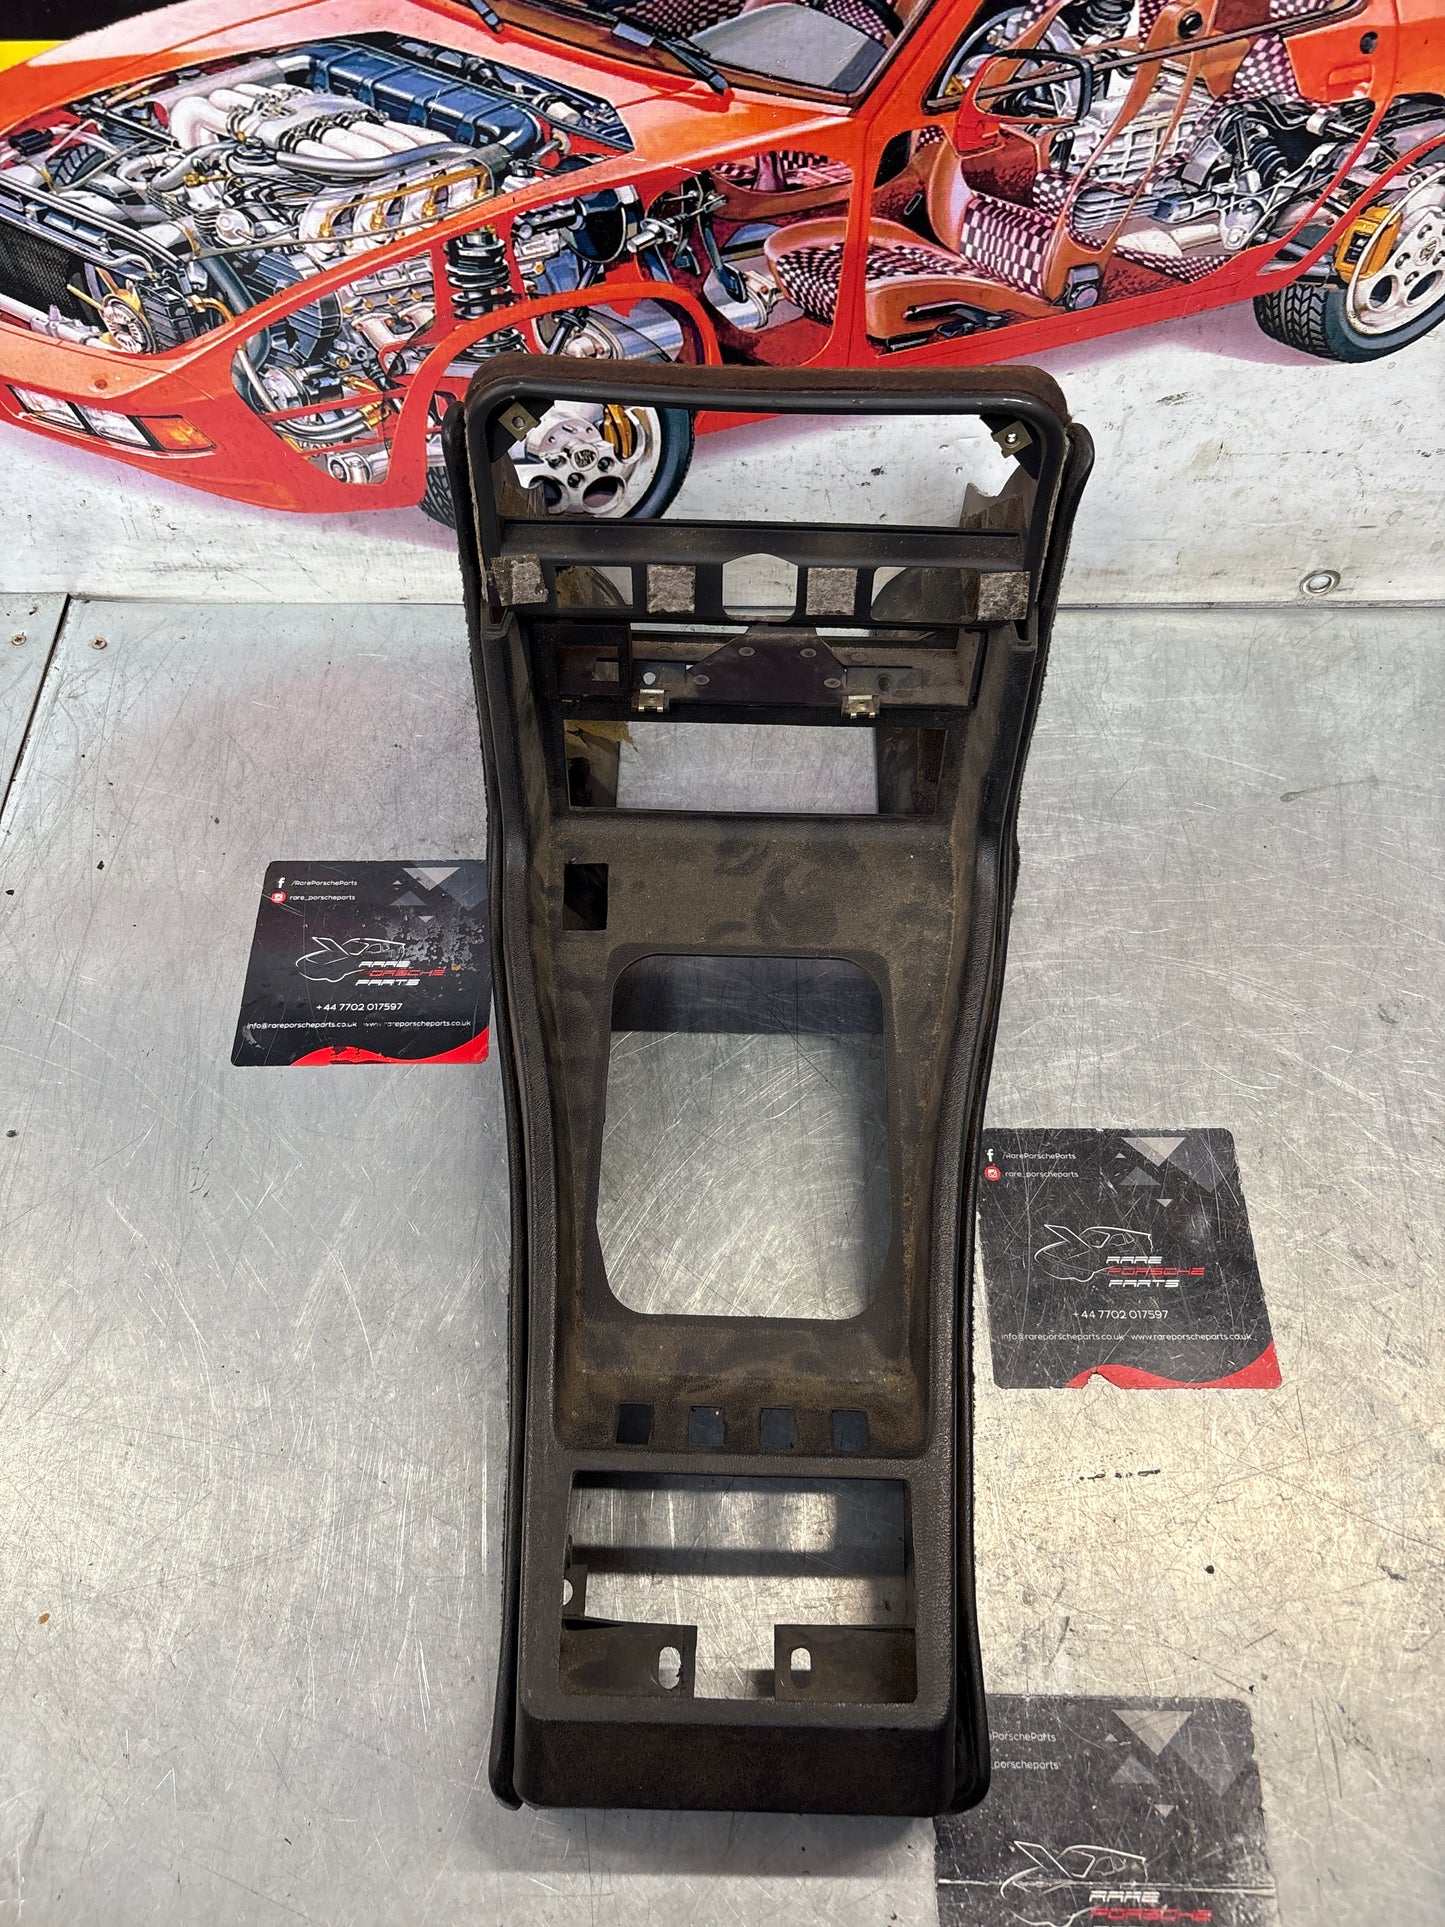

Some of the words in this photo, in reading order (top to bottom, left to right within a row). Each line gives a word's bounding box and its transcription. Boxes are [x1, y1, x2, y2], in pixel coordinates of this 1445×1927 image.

[358, 960, 411, 968] RARE
[361, 969, 446, 977] ORSCHE
[355, 979, 420, 987] PARTS
[316, 1003, 337, 1011] +44
[339, 1003, 365, 1011] 7702
[366, 1002, 403, 1011] 017597
[246, 1021, 358, 1030] info@rareporscheparts.co.uk
[1001, 1152, 1077, 1160] /RarePorscheParts
[1004, 1170, 1080, 1179] rare_porscheparts
[1105, 1256, 1163, 1265] RARE
[1106, 1267, 1206, 1276] PORSCHE
[1108, 1279, 1180, 1288] PARTS
[1072, 1309, 1096, 1320] +44
[1097, 1309, 1128, 1320] 7702
[1128, 1309, 1169, 1320] 017597
[1001, 1332, 1125, 1342] info@rareporscheparts.co.uk
[1130, 1332, 1253, 1342] www.rareporscheparts.co.uk
[1089, 1890, 1161, 1903] RARE
[1089, 1908, 1213, 1922] PORSCHE
